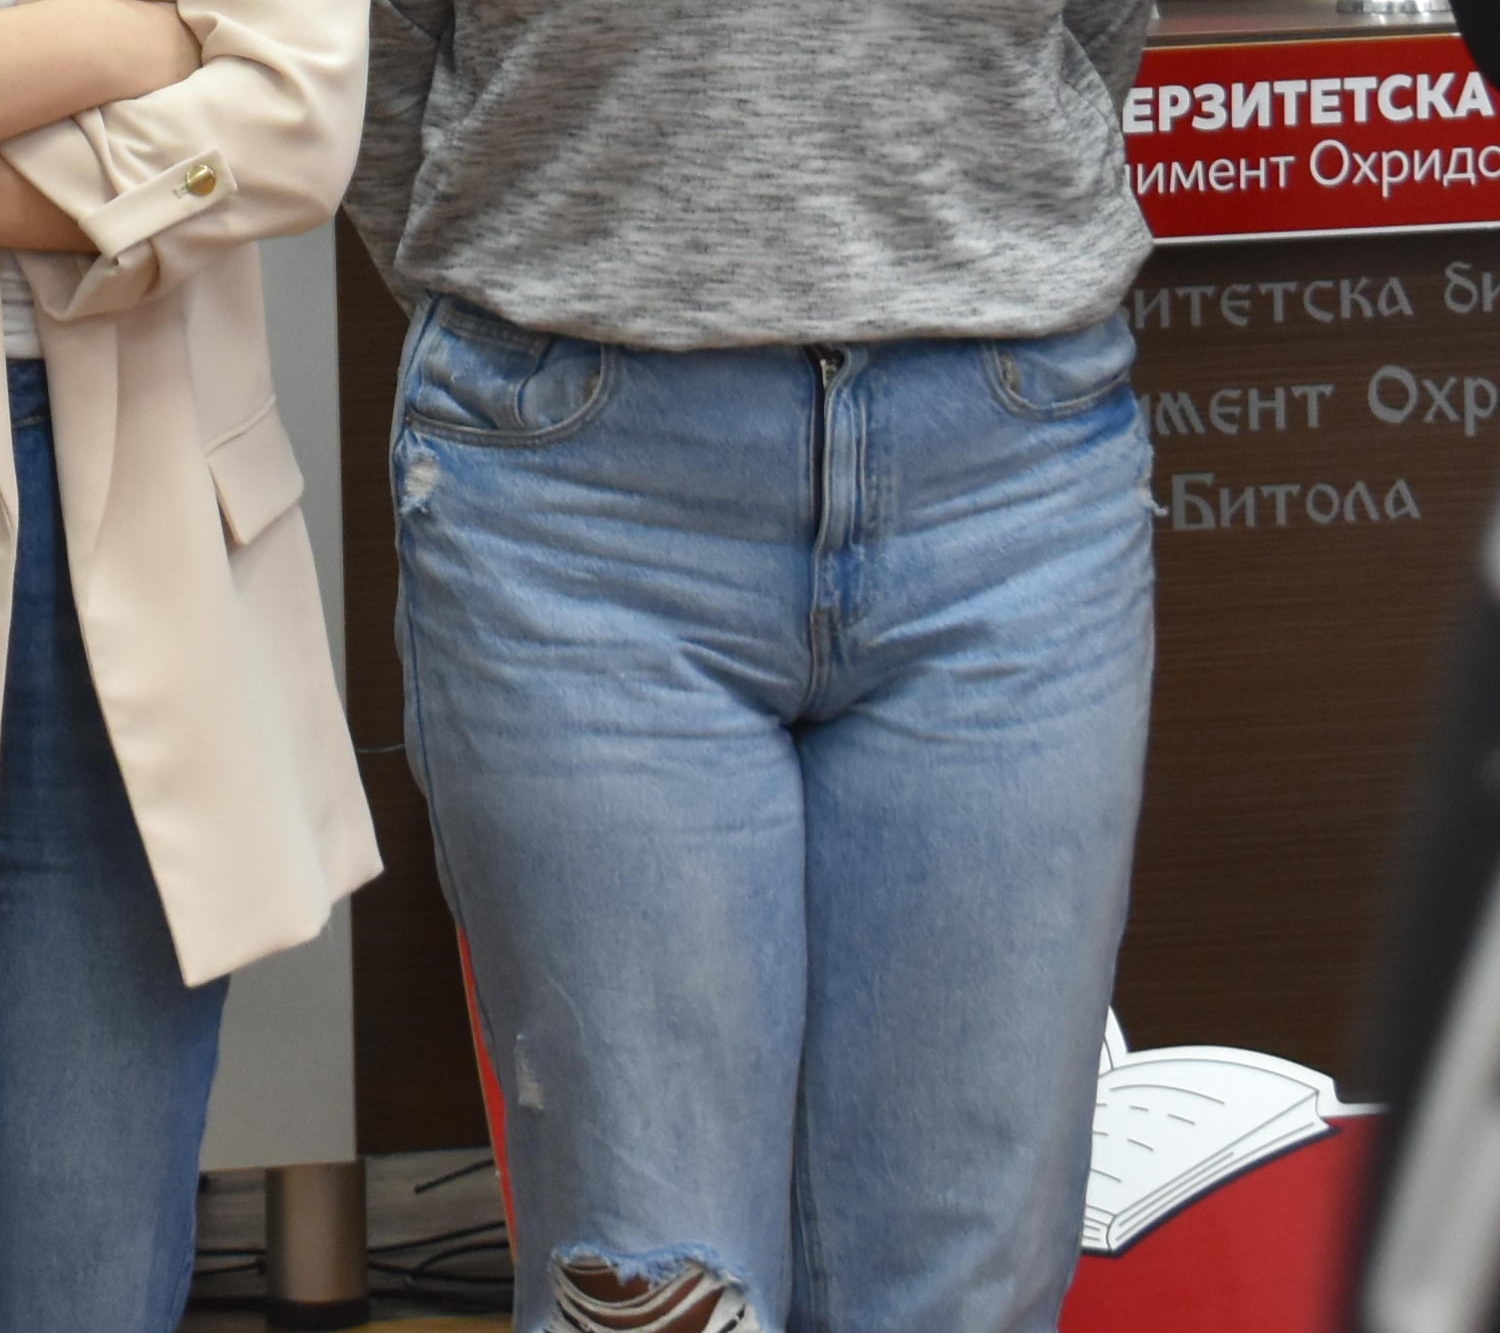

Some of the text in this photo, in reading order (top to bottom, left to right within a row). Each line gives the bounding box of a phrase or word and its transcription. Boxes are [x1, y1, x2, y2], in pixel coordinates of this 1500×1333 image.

[1122, 71, 1494, 133] ЕРЗИТЕТСКА
[1121, 276, 1414, 330] итетска
[1139, 383, 1335, 436] мент
